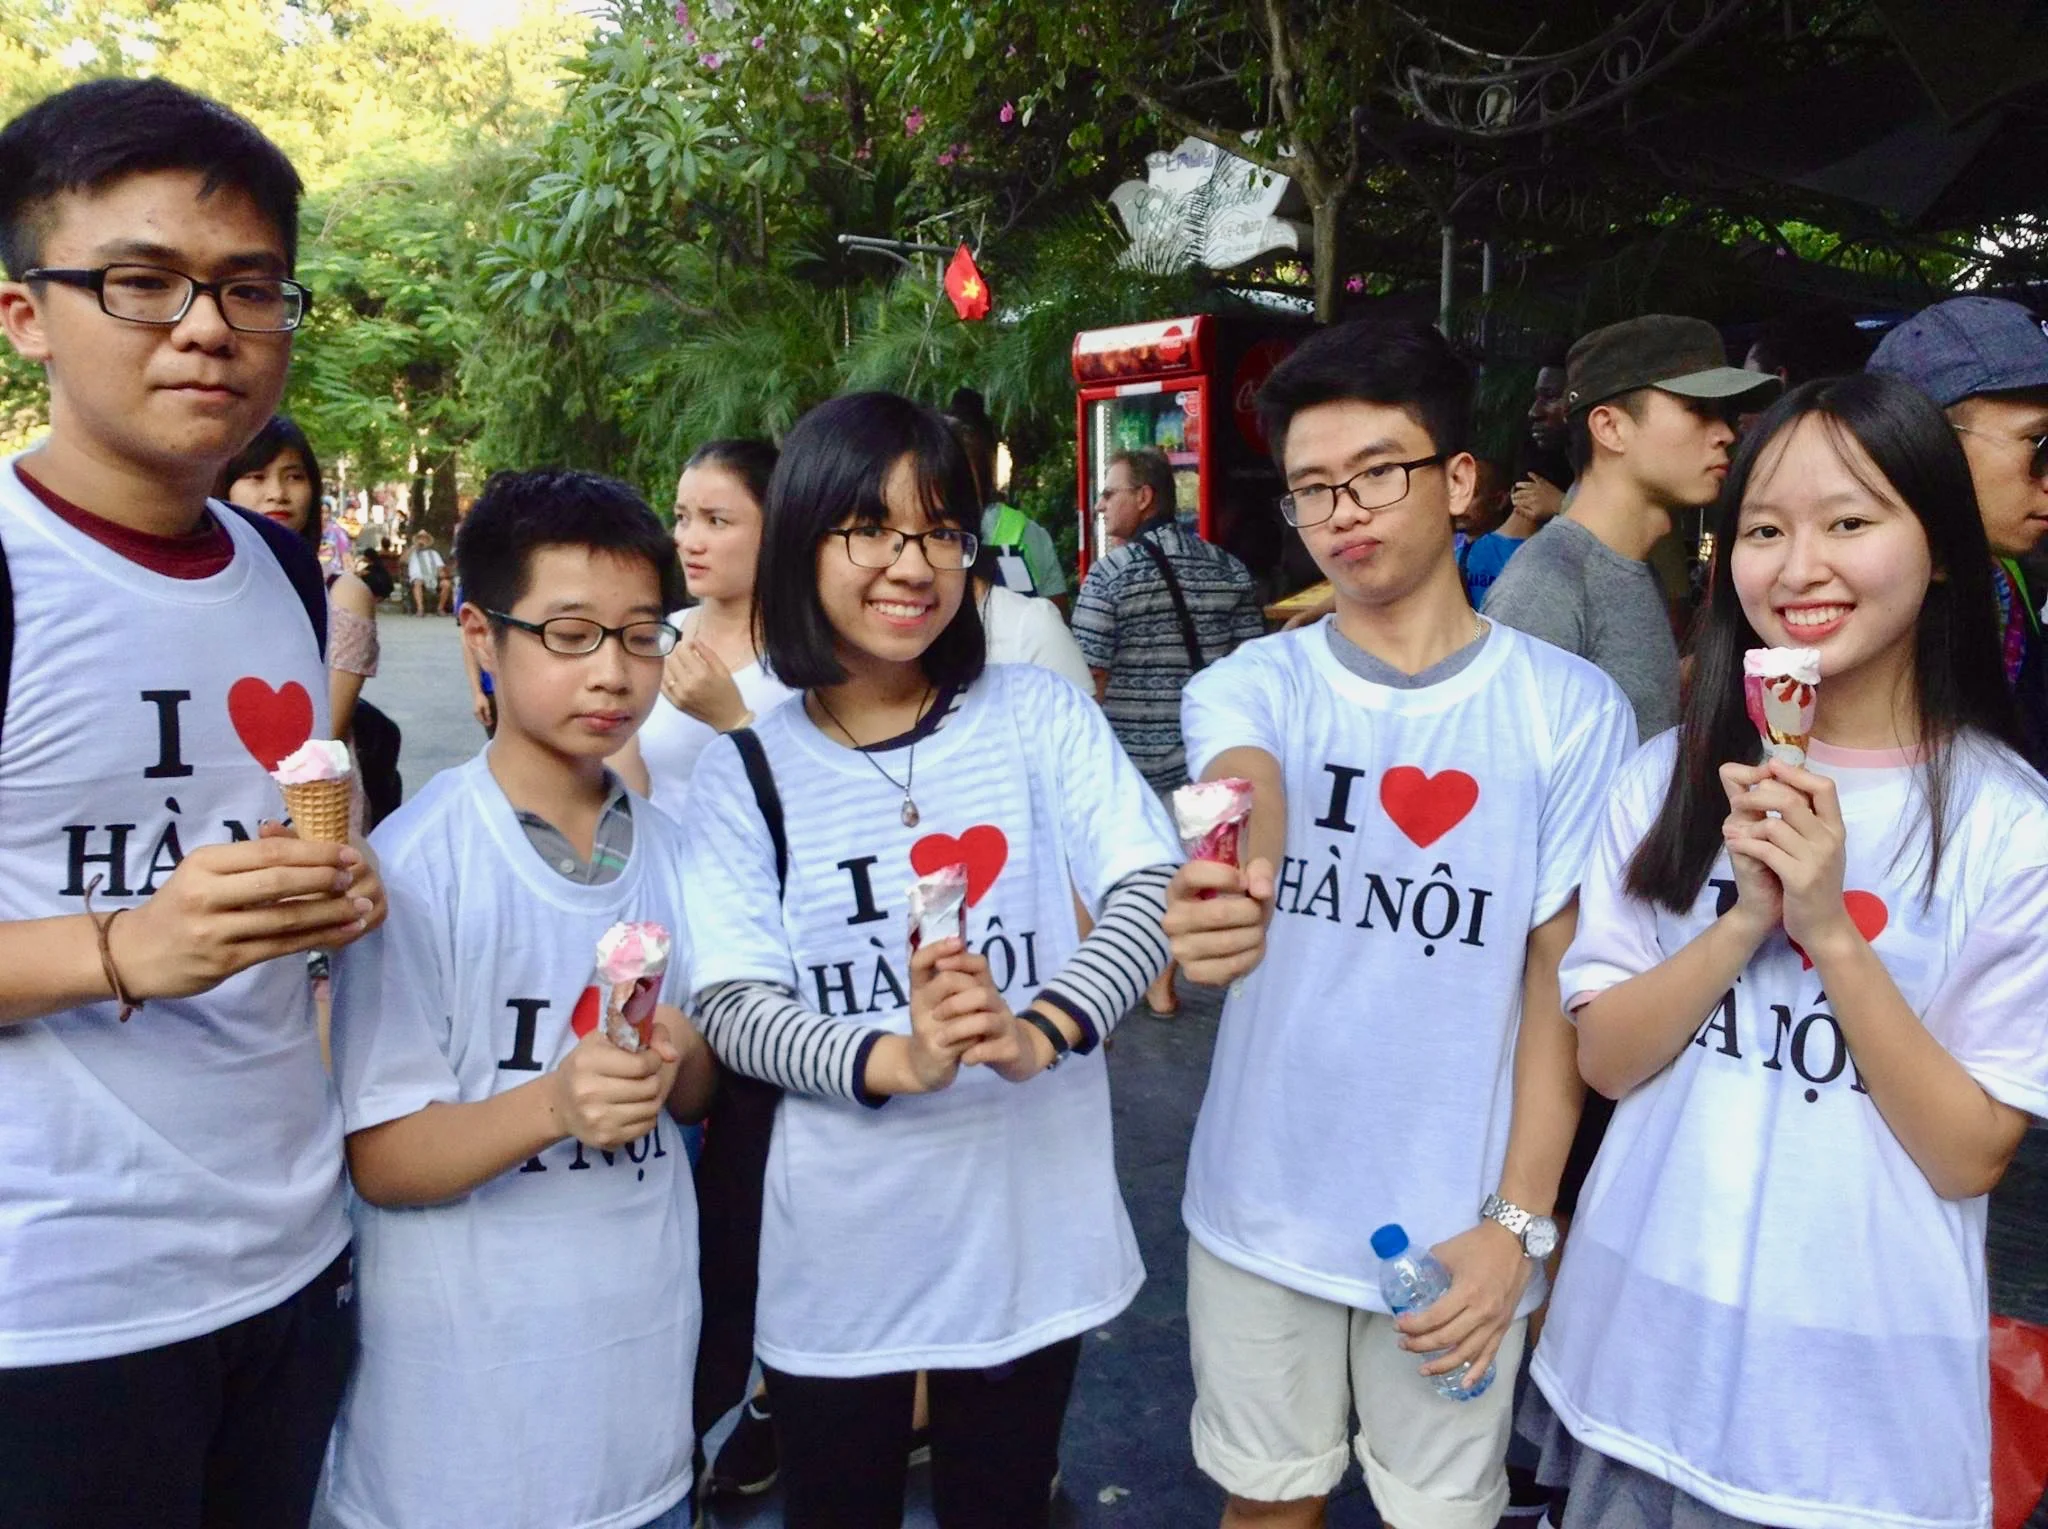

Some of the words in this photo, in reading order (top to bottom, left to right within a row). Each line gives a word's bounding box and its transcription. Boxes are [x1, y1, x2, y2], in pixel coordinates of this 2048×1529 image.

[141, 690, 193, 778] I
[1314, 763, 1366, 833] I
[837, 855, 889, 925] I
[1275, 845, 1342, 923] HÀ
[1356, 862, 1493, 957] NỘI
[808, 936, 910, 1016] HÀ
[498, 998, 551, 1071] I
